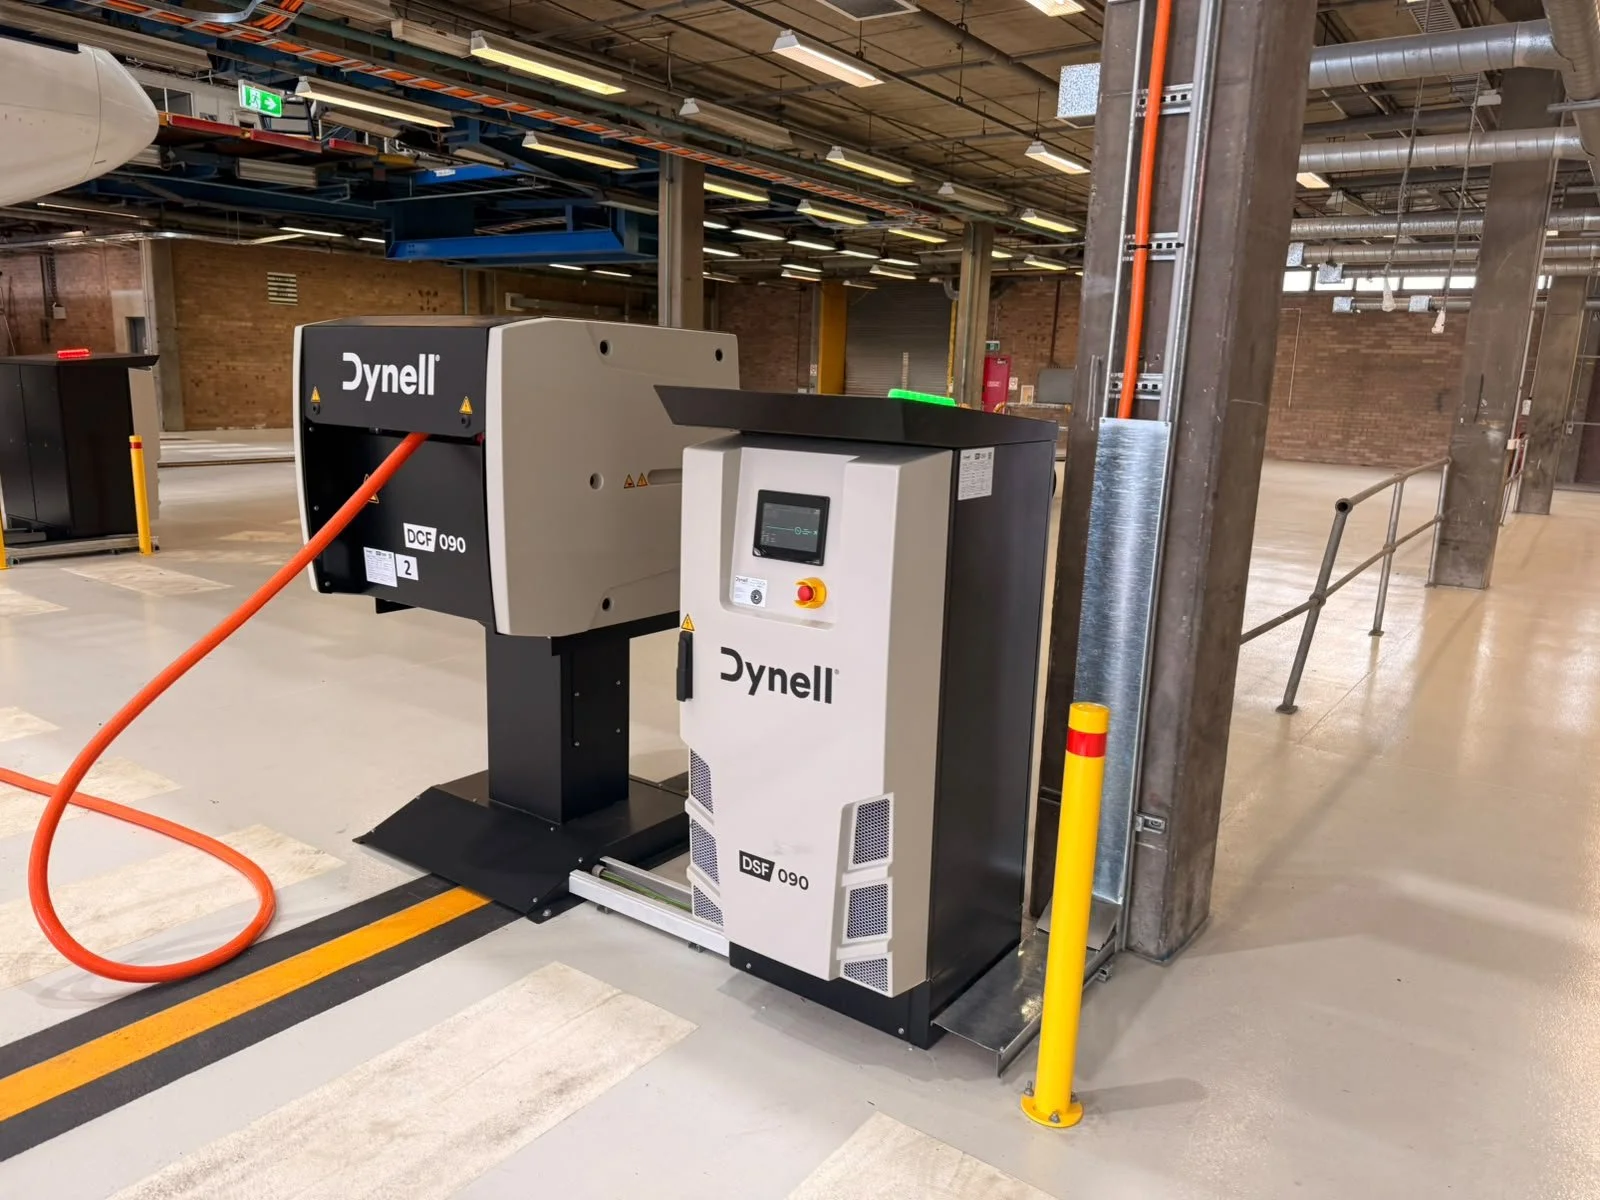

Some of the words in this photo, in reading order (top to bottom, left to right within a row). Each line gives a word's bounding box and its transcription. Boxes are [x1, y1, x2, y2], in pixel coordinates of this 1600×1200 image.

[407, 528, 432, 547] DCF
[439, 533, 466, 553] 090
[403, 560, 412, 576] 2
[742, 855, 770, 876] DSF
[778, 868, 809, 890] 090
